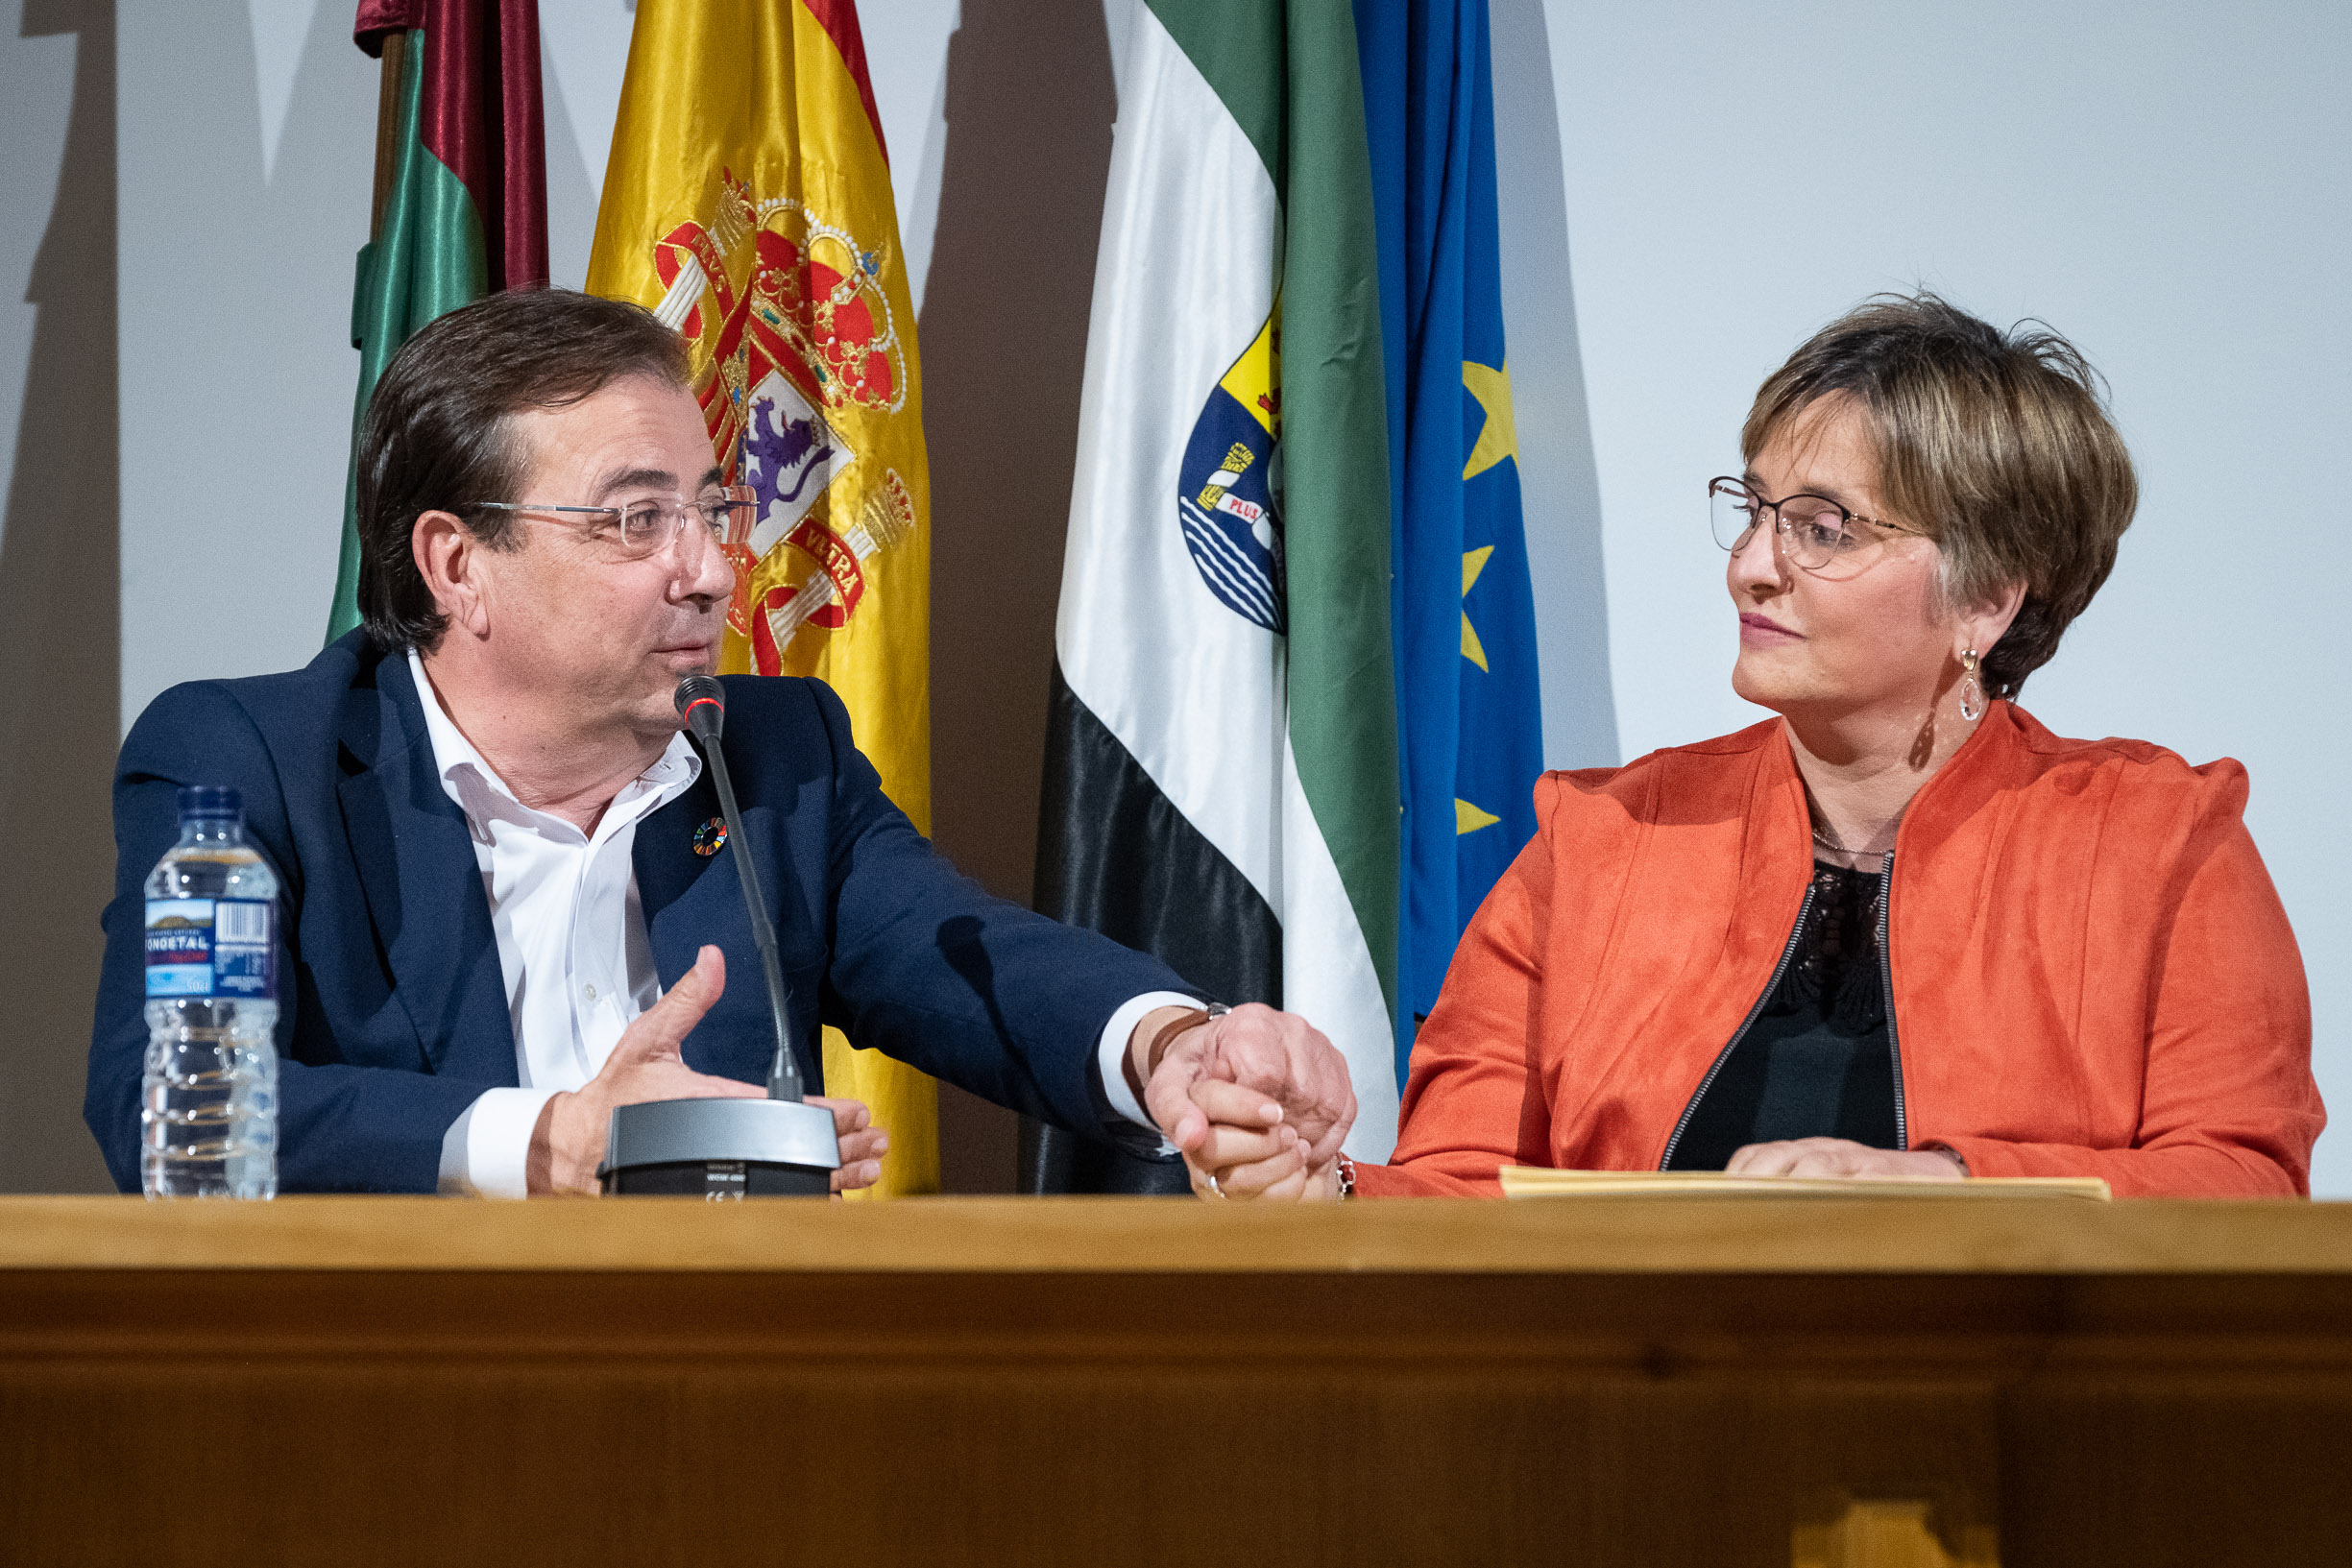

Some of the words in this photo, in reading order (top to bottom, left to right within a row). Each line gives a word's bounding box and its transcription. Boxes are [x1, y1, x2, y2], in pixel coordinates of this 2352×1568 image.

[691, 233, 727, 292] PLVS
[1229, 498, 1258, 519] PLUS
[806, 527, 859, 595] VLTRA
[146, 935, 209, 952] ONDETAL
